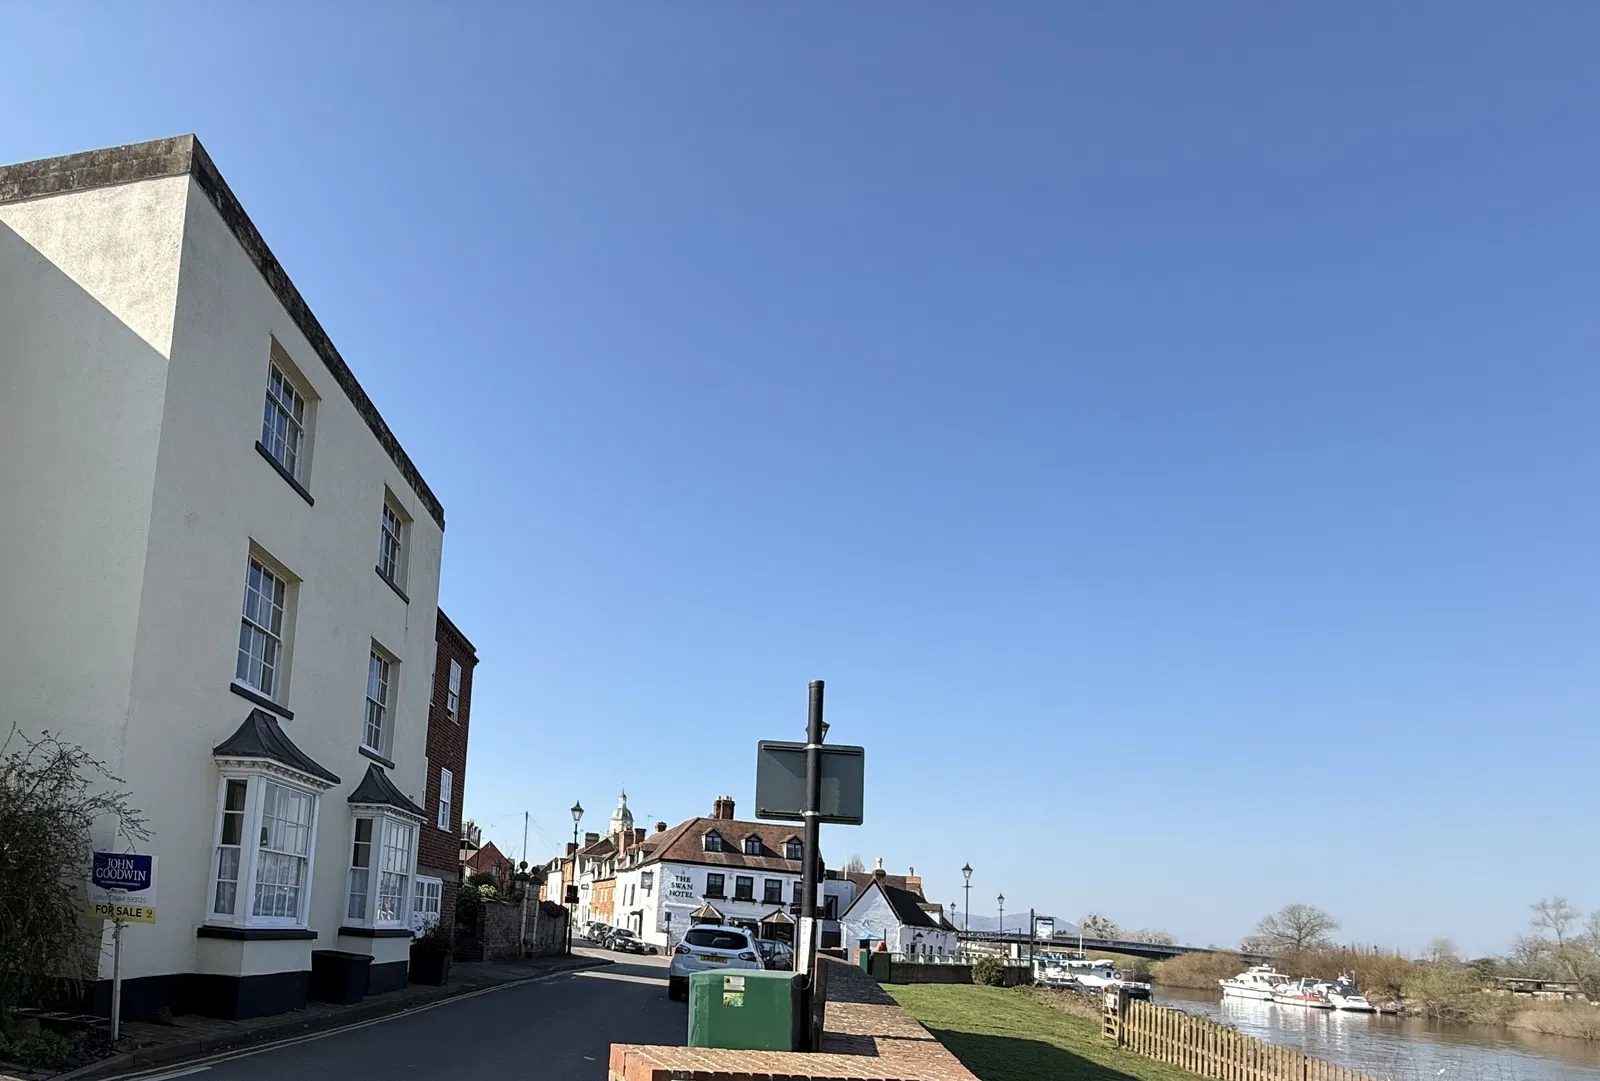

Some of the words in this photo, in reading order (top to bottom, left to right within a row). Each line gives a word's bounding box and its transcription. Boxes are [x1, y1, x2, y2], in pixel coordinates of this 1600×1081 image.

[107, 858, 135, 870] JOHN
[96, 868, 147, 881] GOODWIN
[671, 882, 693, 890] SWAN
[669, 890, 694, 898] HOTEL
[95, 904, 114, 915] FOR
[116, 906, 142, 917] SALE
